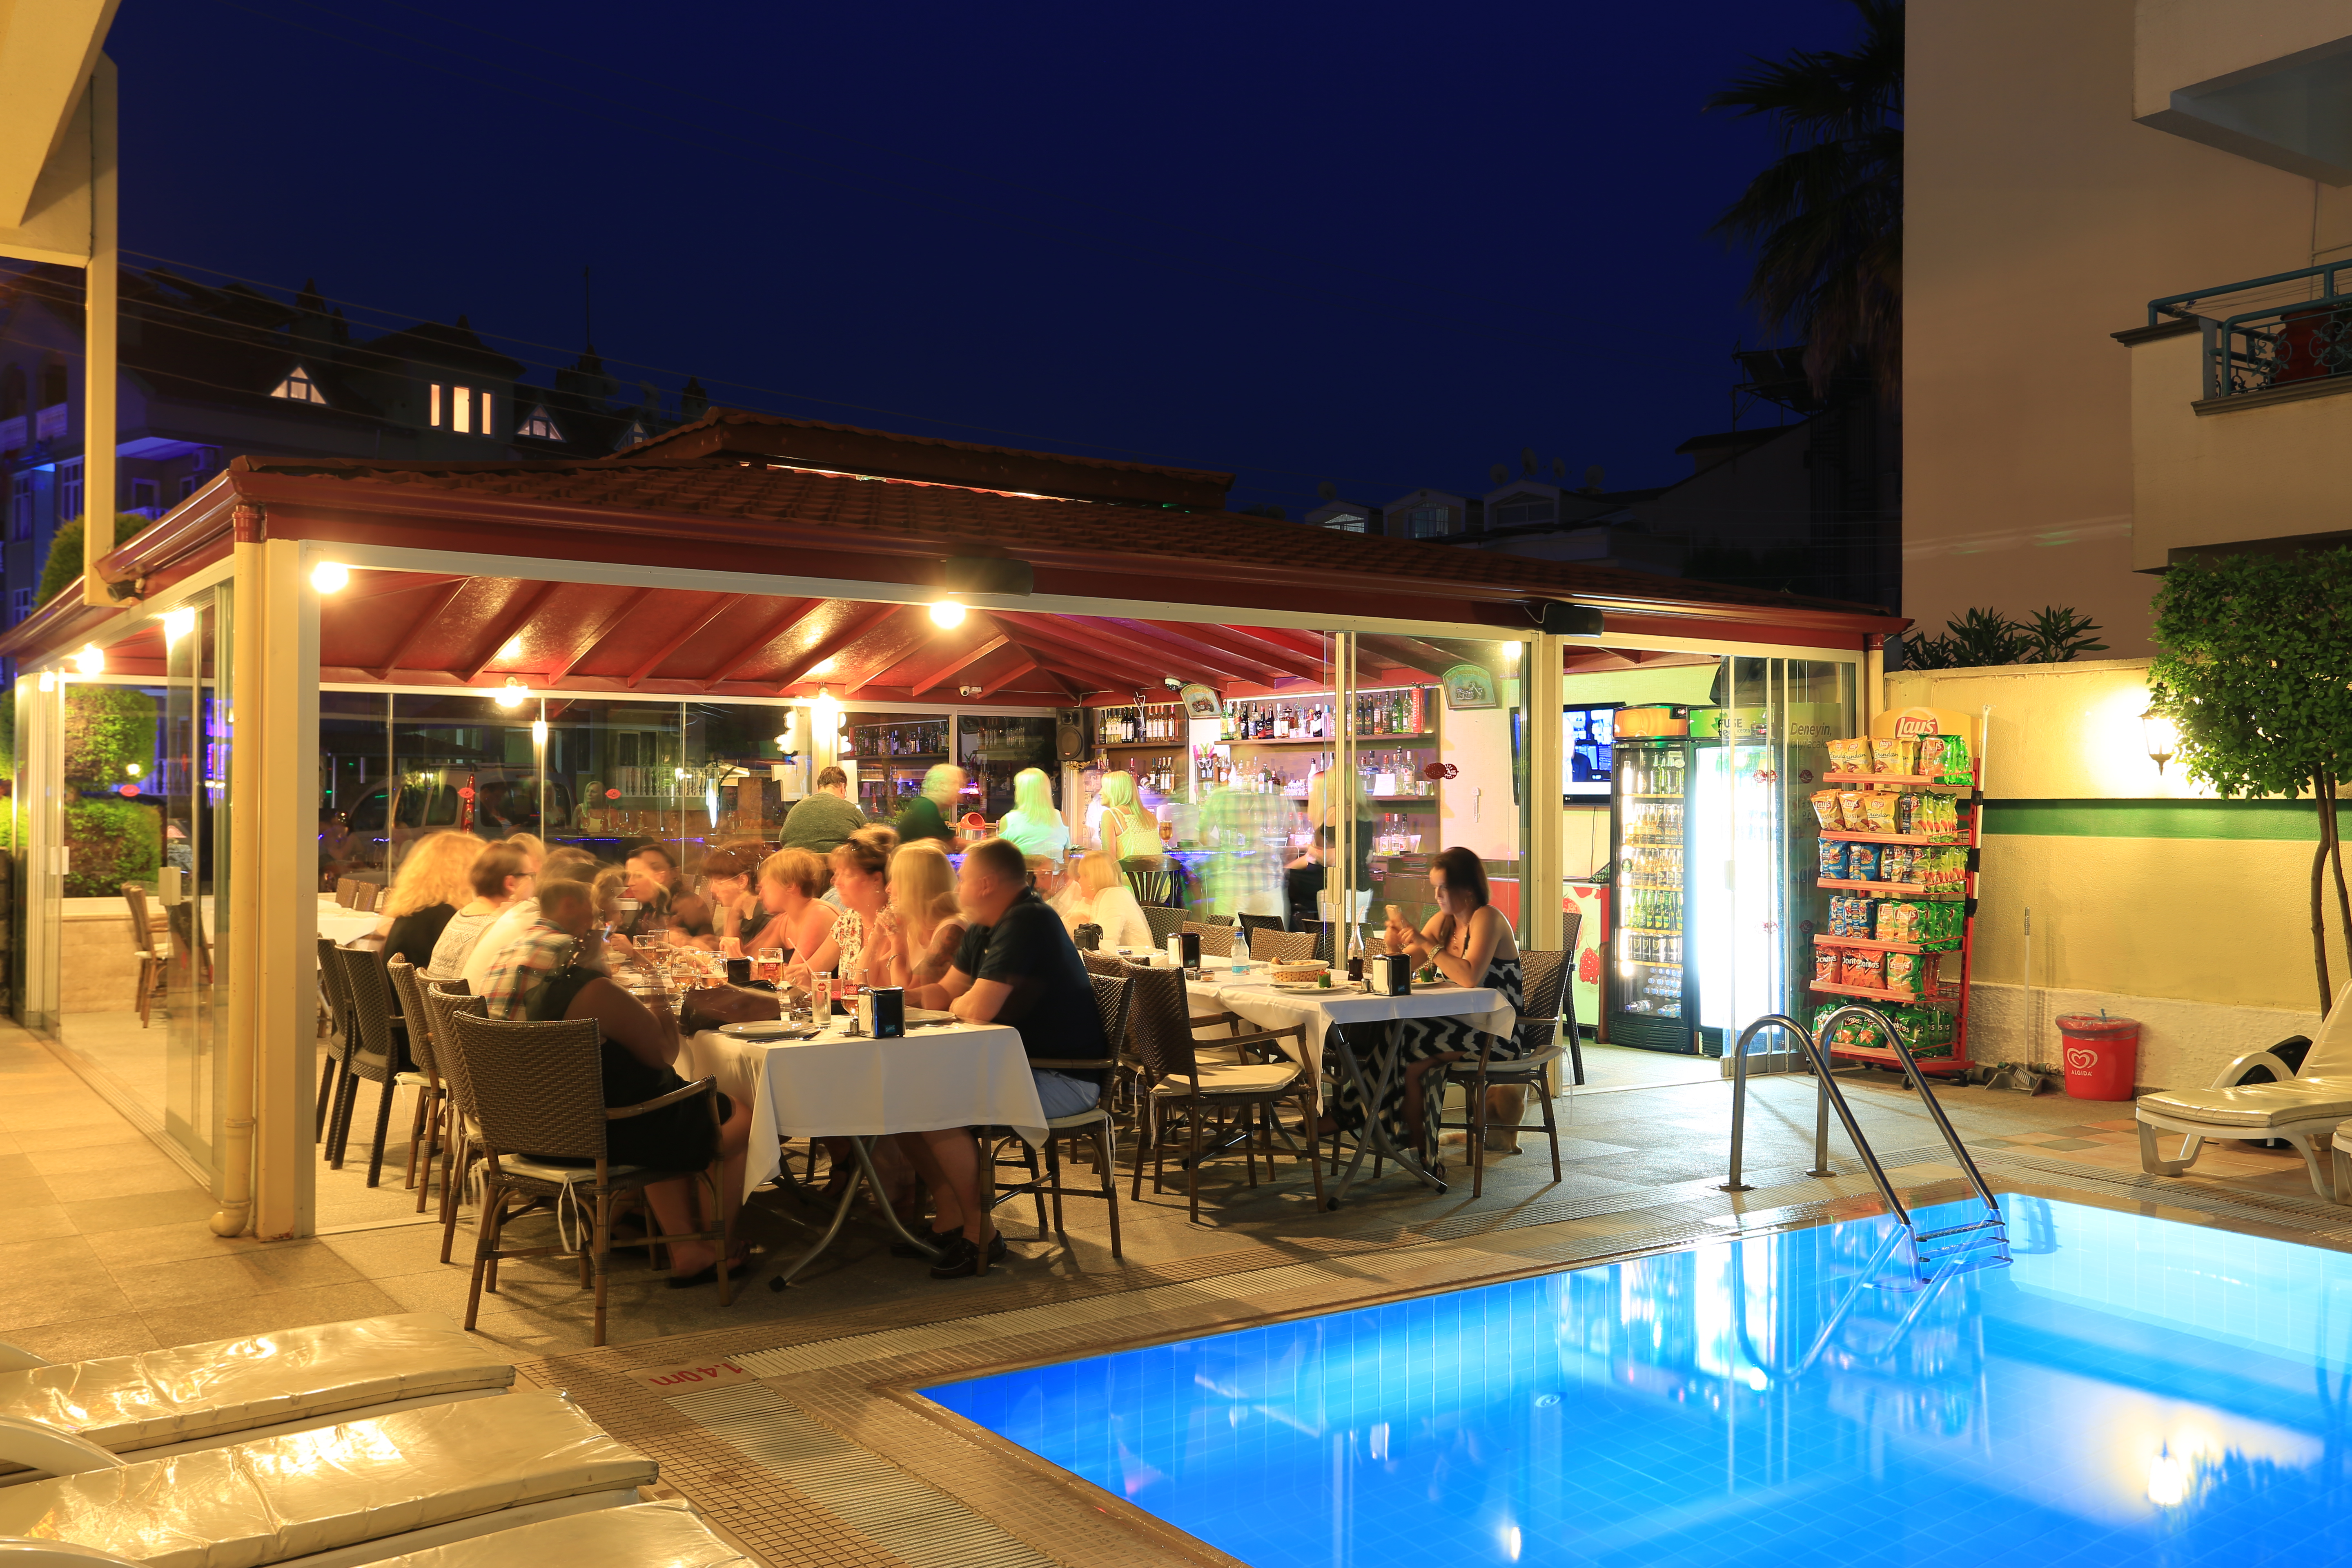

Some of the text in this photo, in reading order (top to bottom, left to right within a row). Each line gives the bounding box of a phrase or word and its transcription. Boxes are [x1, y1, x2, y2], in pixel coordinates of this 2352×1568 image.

[1790, 722, 1832, 737] Deneyin,
[1897, 718, 1936, 737] Lay's
[1815, 801, 1831, 811] Lay's
[1843, 800, 1858, 810] Lay's
[648, 1363, 744, 1386] 1.40m
